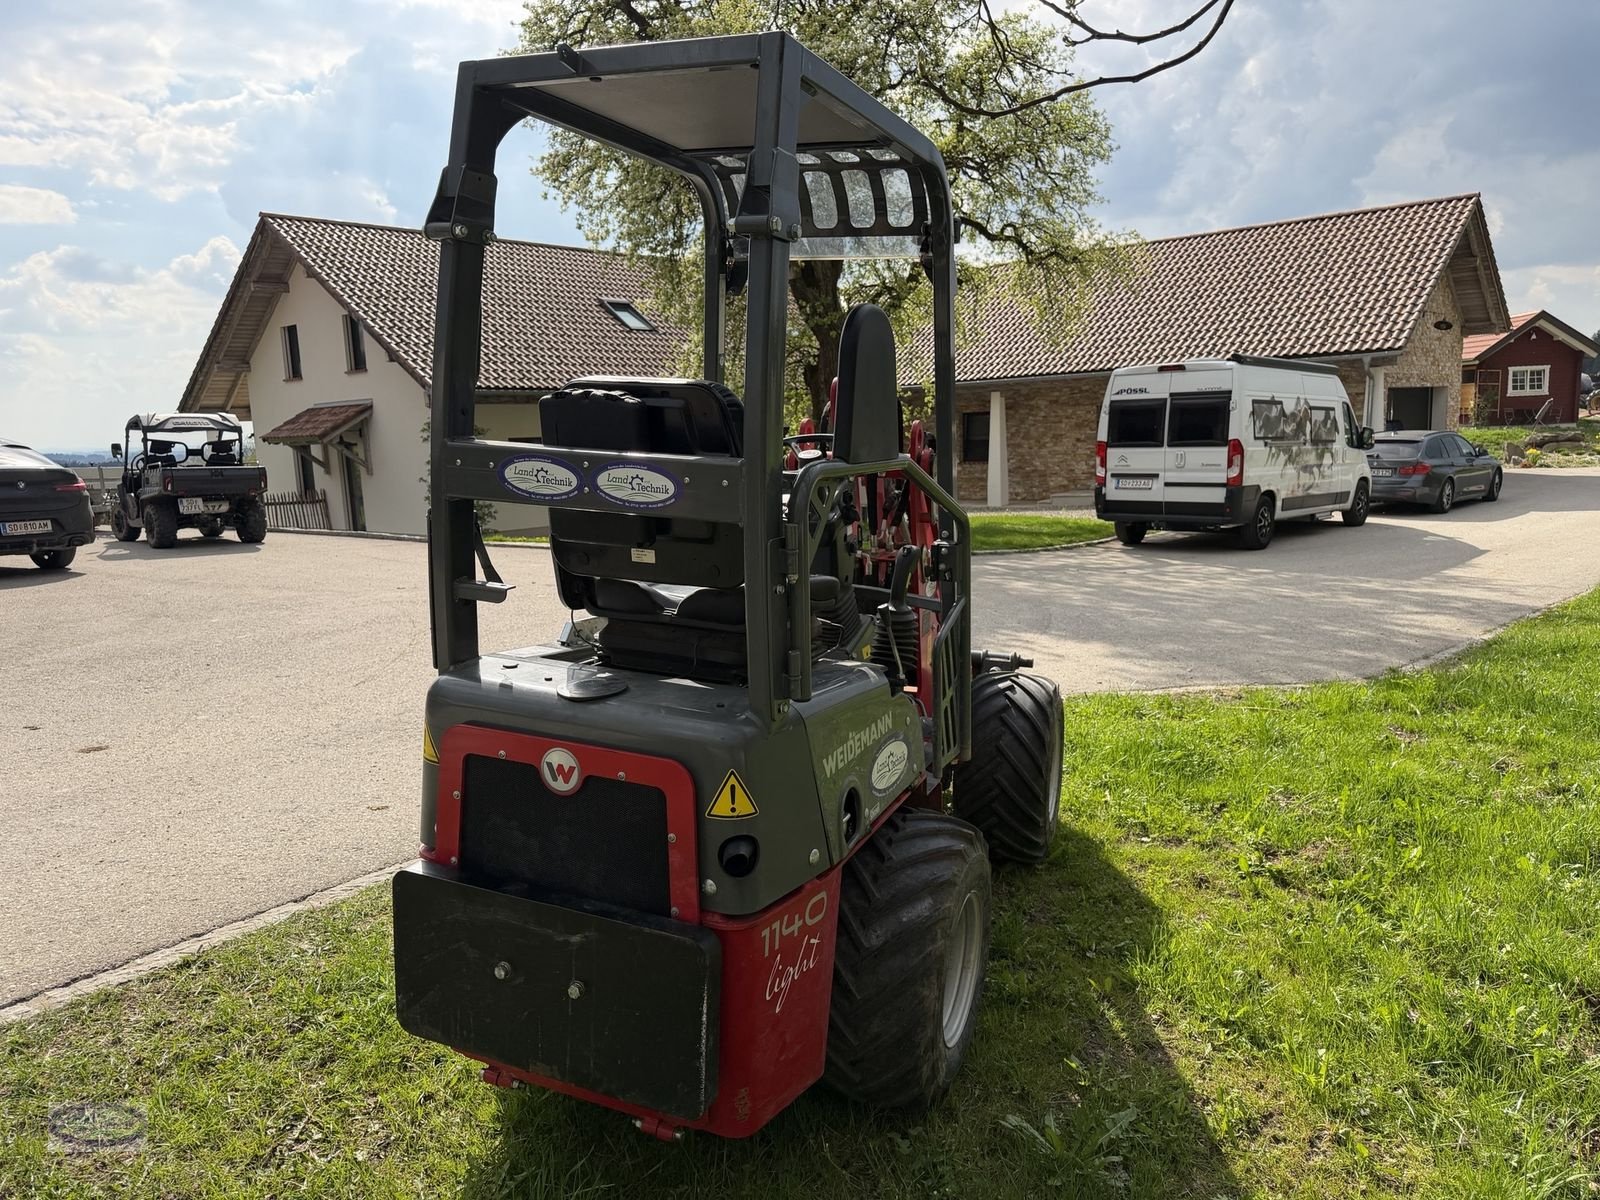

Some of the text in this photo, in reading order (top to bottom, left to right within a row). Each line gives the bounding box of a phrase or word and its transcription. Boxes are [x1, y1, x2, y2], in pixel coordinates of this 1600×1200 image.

[514, 466, 573, 487] Land Technik
[607, 473, 670, 495] Land Technik
[8, 521, 48, 531] SD 810 AM
[823, 711, 892, 779] WEIDEMANN
[762, 891, 828, 958] 1140
[766, 932, 820, 1014] light
